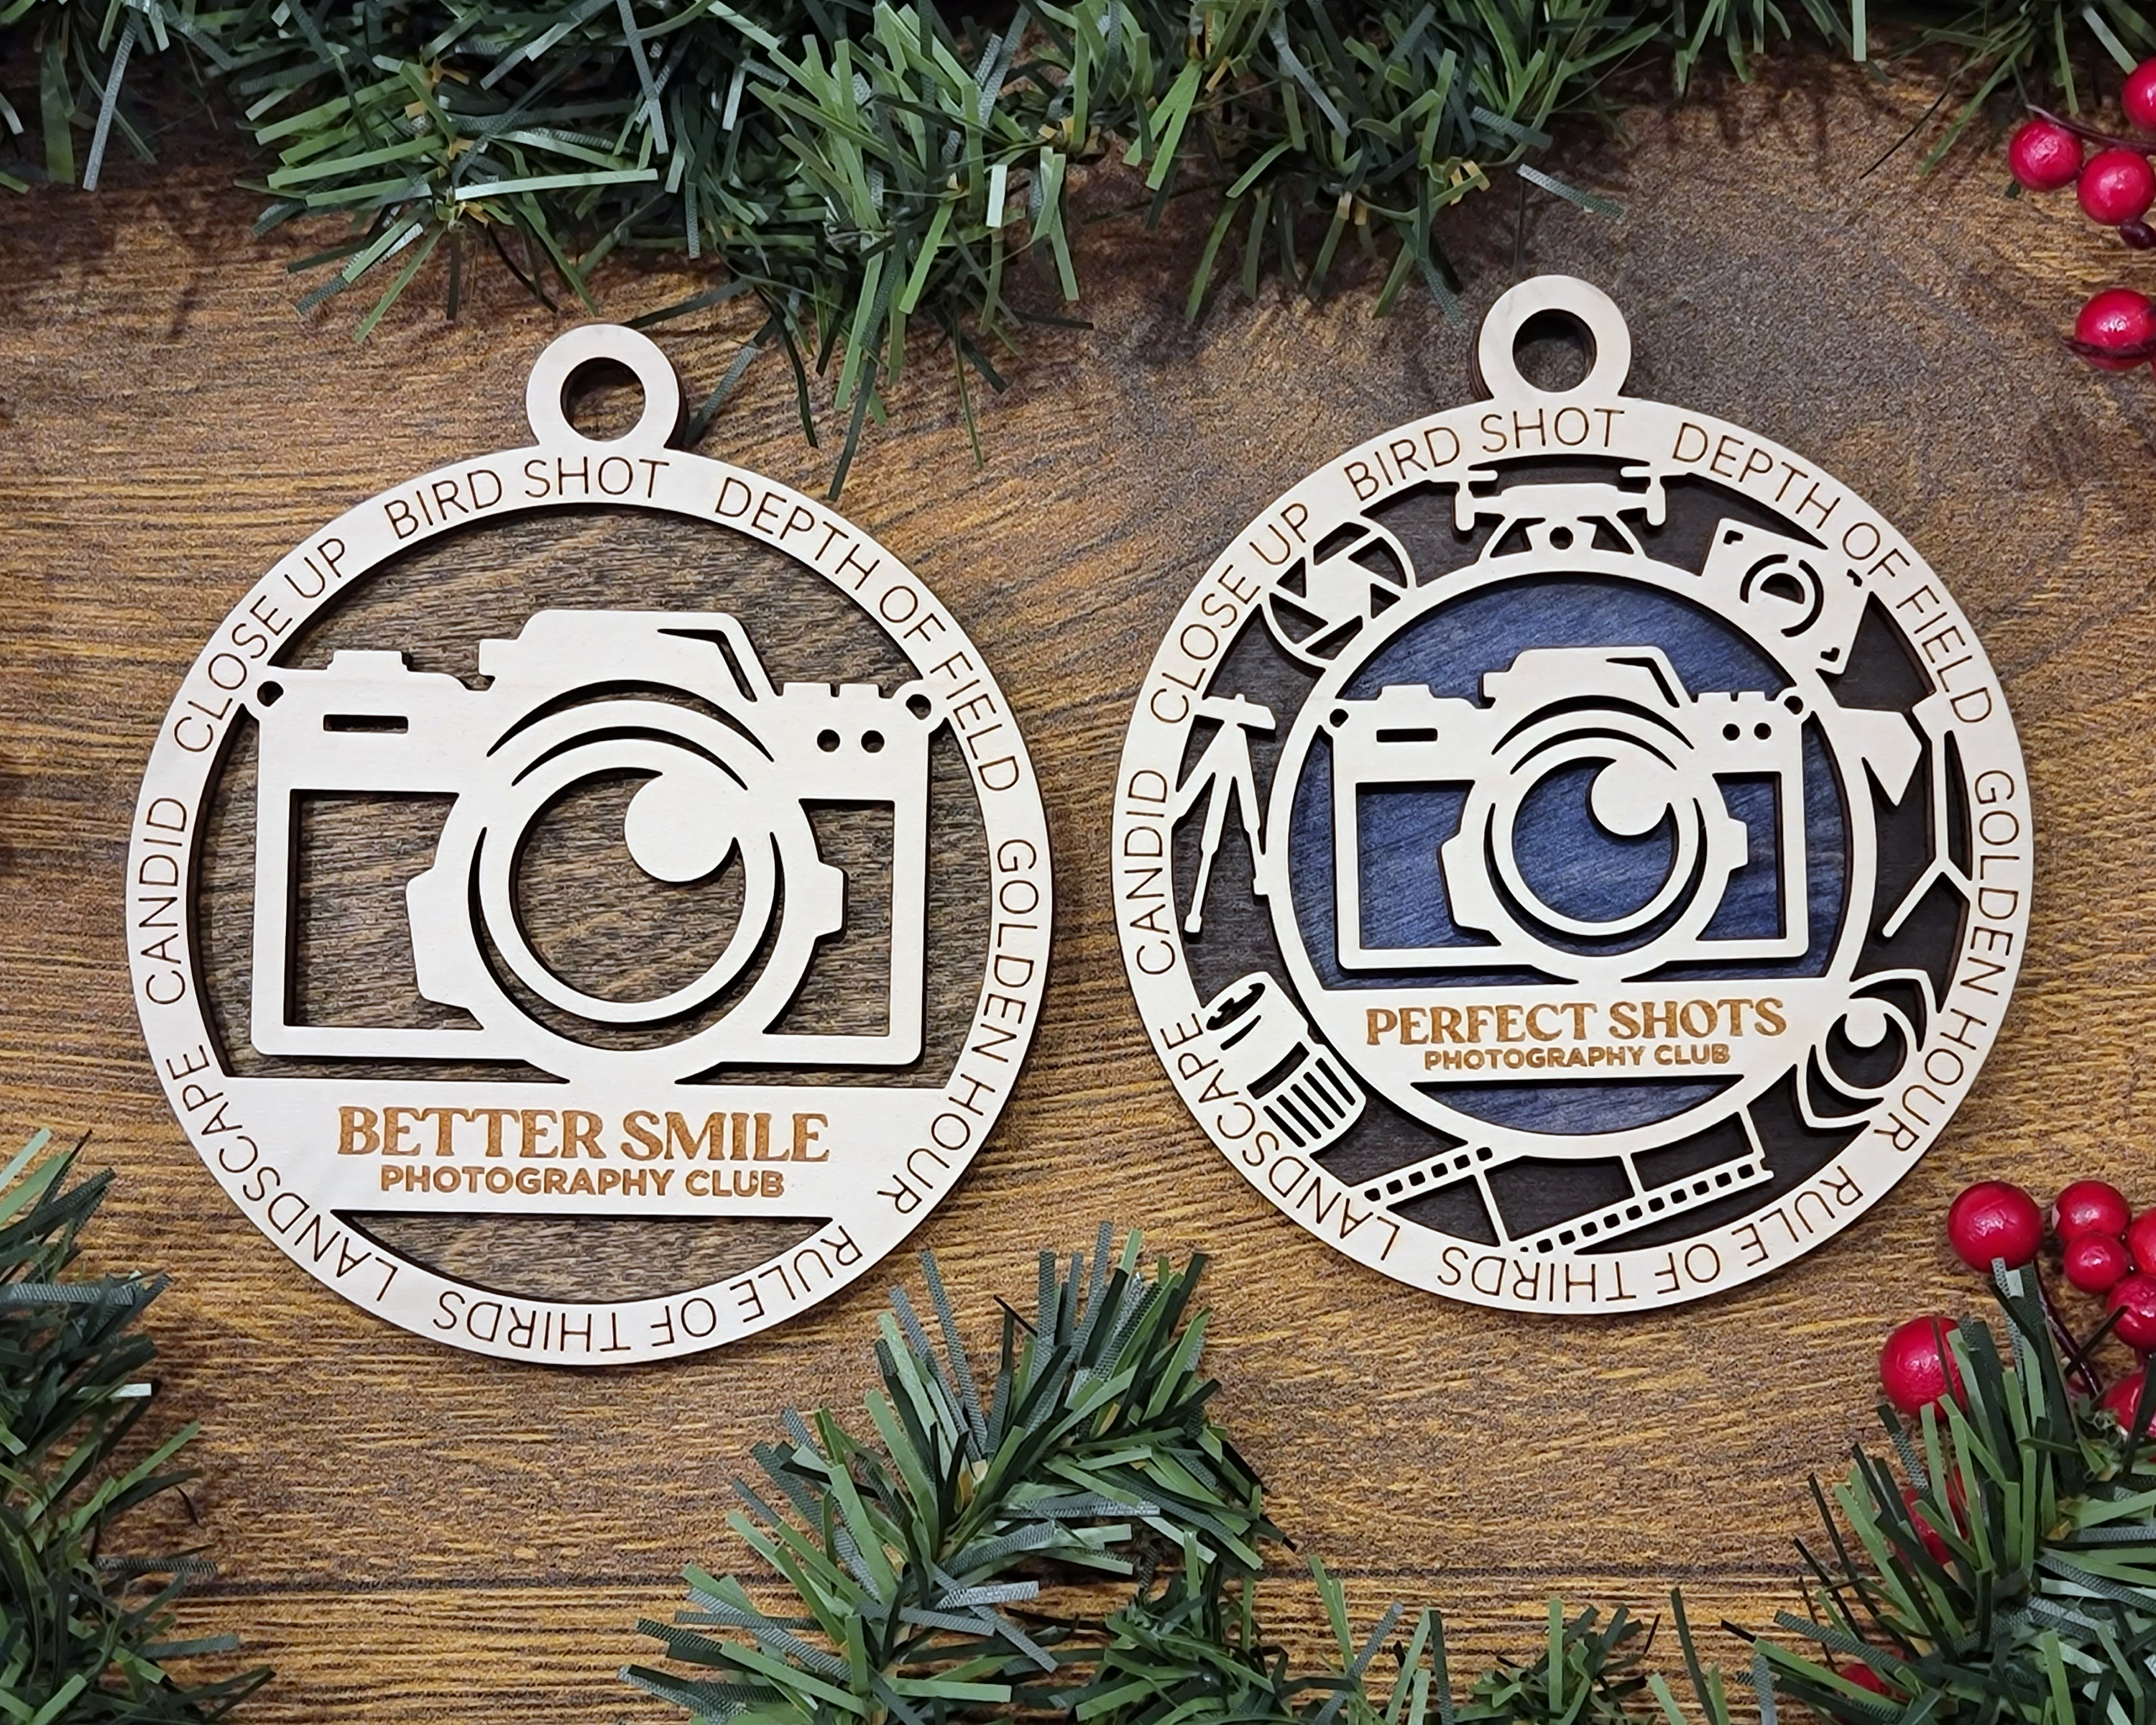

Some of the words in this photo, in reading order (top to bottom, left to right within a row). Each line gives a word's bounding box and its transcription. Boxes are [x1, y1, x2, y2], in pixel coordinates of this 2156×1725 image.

[384, 469, 502, 539] BIRD
[523, 456, 669, 498] SHOT
[1343, 426, 1460, 502] BIRD
[1480, 407, 1625, 453] SHOT
[1150, 564, 1261, 724] CLOSE
[1249, 502, 1309, 566] UP
[1672, 422, 1841, 529] DEPTH
[1842, 522, 1911, 578] OF
[1896, 584, 1993, 723] FIELD
[174, 596, 292, 753] CLOSE
[284, 537, 346, 599] UP
[714, 477, 880, 591] DEPTH
[879, 585, 946, 645] OF
[929, 651, 1020, 791] FIELD
[138, 797, 188, 1005] CANDID
[1124, 769, 1176, 975] CANDID
[1960, 770, 2020, 996] GOLDEN
[972, 839, 1039, 1062] GOLDEN
[1365, 1003, 1597, 1045] PERFECT
[1608, 998, 1787, 1039] SHOTS
[1424, 1046, 1644, 1070] PHOTOGRAPHY
[1654, 1044, 1731, 1064] CLUB
[1874, 1008, 1987, 1151] HOUR
[166, 1044, 398, 1302] LANDSCAPE
[337, 1105, 607, 1161] BETTER
[620, 1109, 831, 1163] SMILE
[380, 1164, 675, 1197] PHOTOGRAPHY
[685, 1169, 785, 1198] CLUB
[877, 1074, 996, 1214] HOUR
[1160, 1013, 1401, 1261] LANDSCAPE
[729, 1225, 863, 1323] RULE
[1437, 1246, 1636, 1303] THIRDS
[1654, 1243, 1720, 1294] OF
[1731, 1165, 1864, 1266] RULE
[433, 1290, 631, 1352] THIRDS
[650, 1297, 717, 1347] OF
